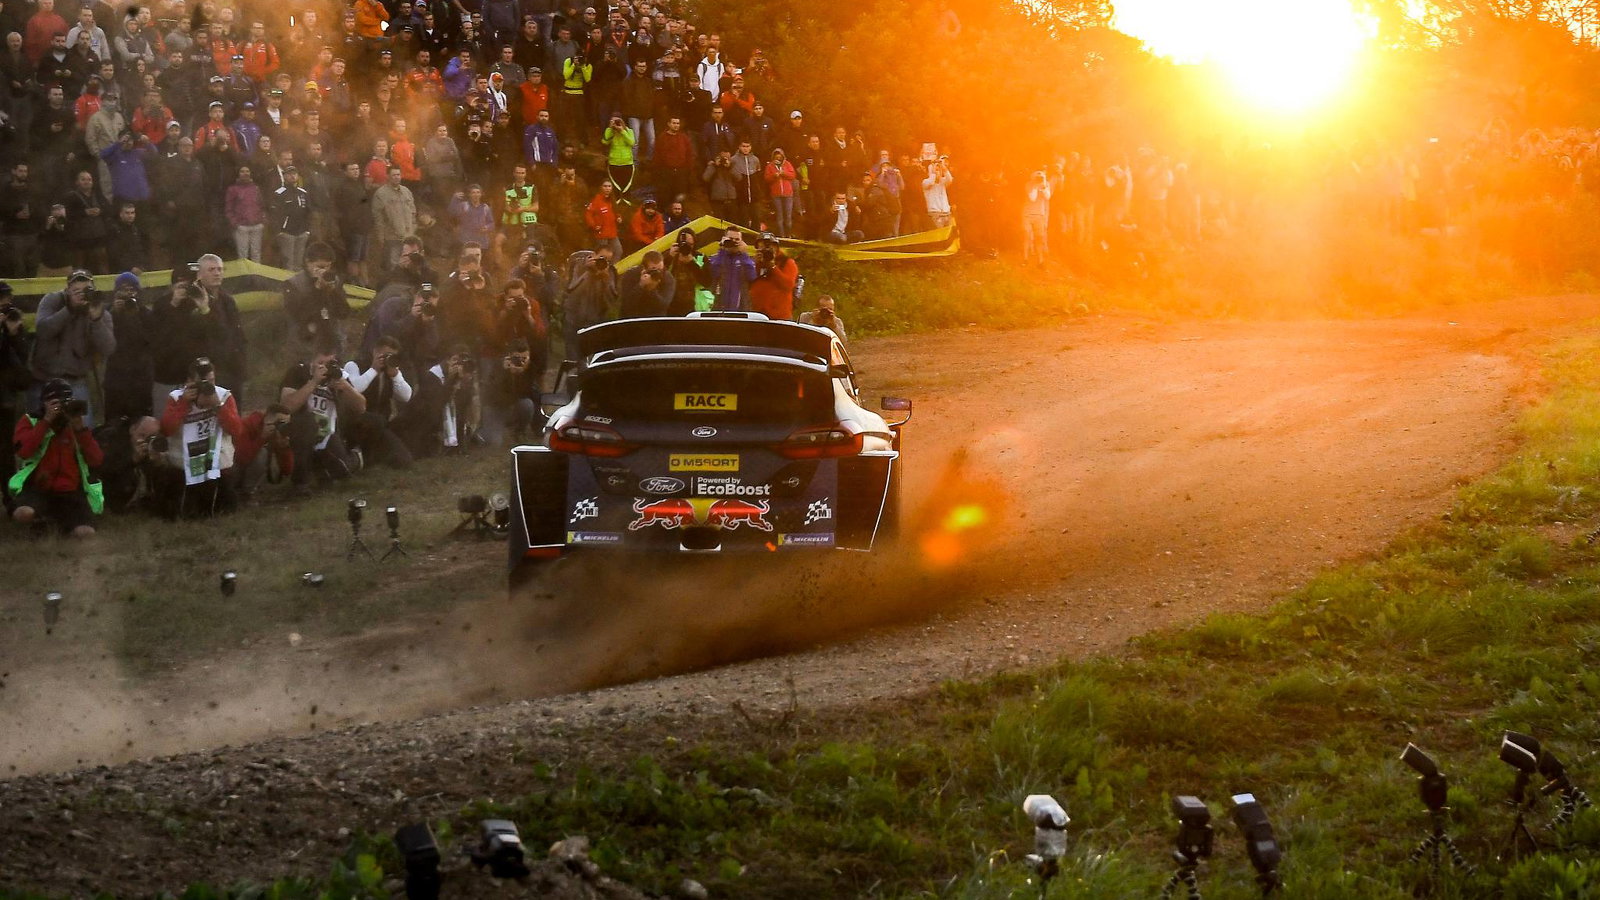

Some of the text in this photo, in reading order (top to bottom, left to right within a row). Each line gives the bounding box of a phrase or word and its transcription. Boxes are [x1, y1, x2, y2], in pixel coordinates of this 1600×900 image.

[313, 396, 327, 410] 10
[685, 395, 726, 407] RACC
[197, 420, 210, 435] 22
[646, 479, 677, 491] Ford
[697, 483, 770, 495] EcoBoost
